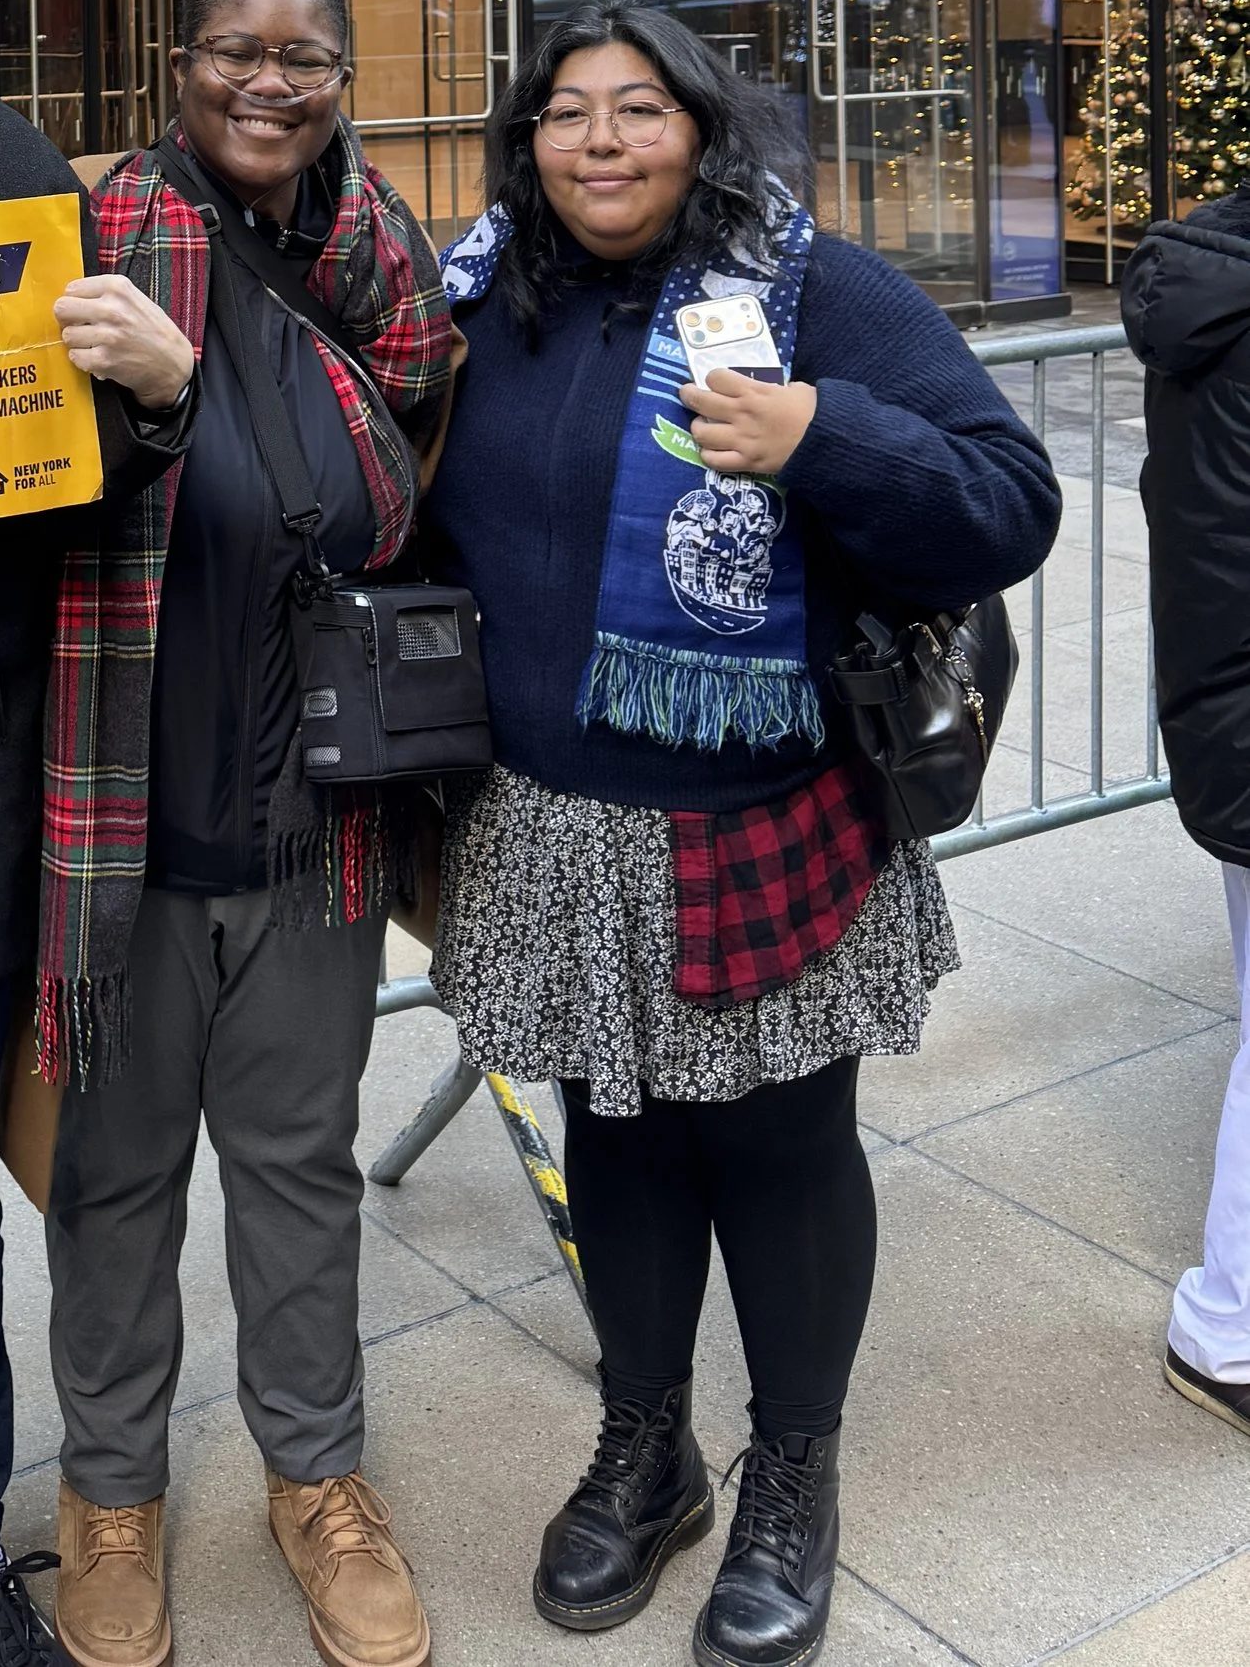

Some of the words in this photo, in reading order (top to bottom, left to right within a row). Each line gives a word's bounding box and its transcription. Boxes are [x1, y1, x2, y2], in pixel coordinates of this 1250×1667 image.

[14, 464, 40, 478] NEW
[42, 457, 72, 473] YORK
[14, 477, 36, 491] FOR
[38, 473, 57, 487] ALL
